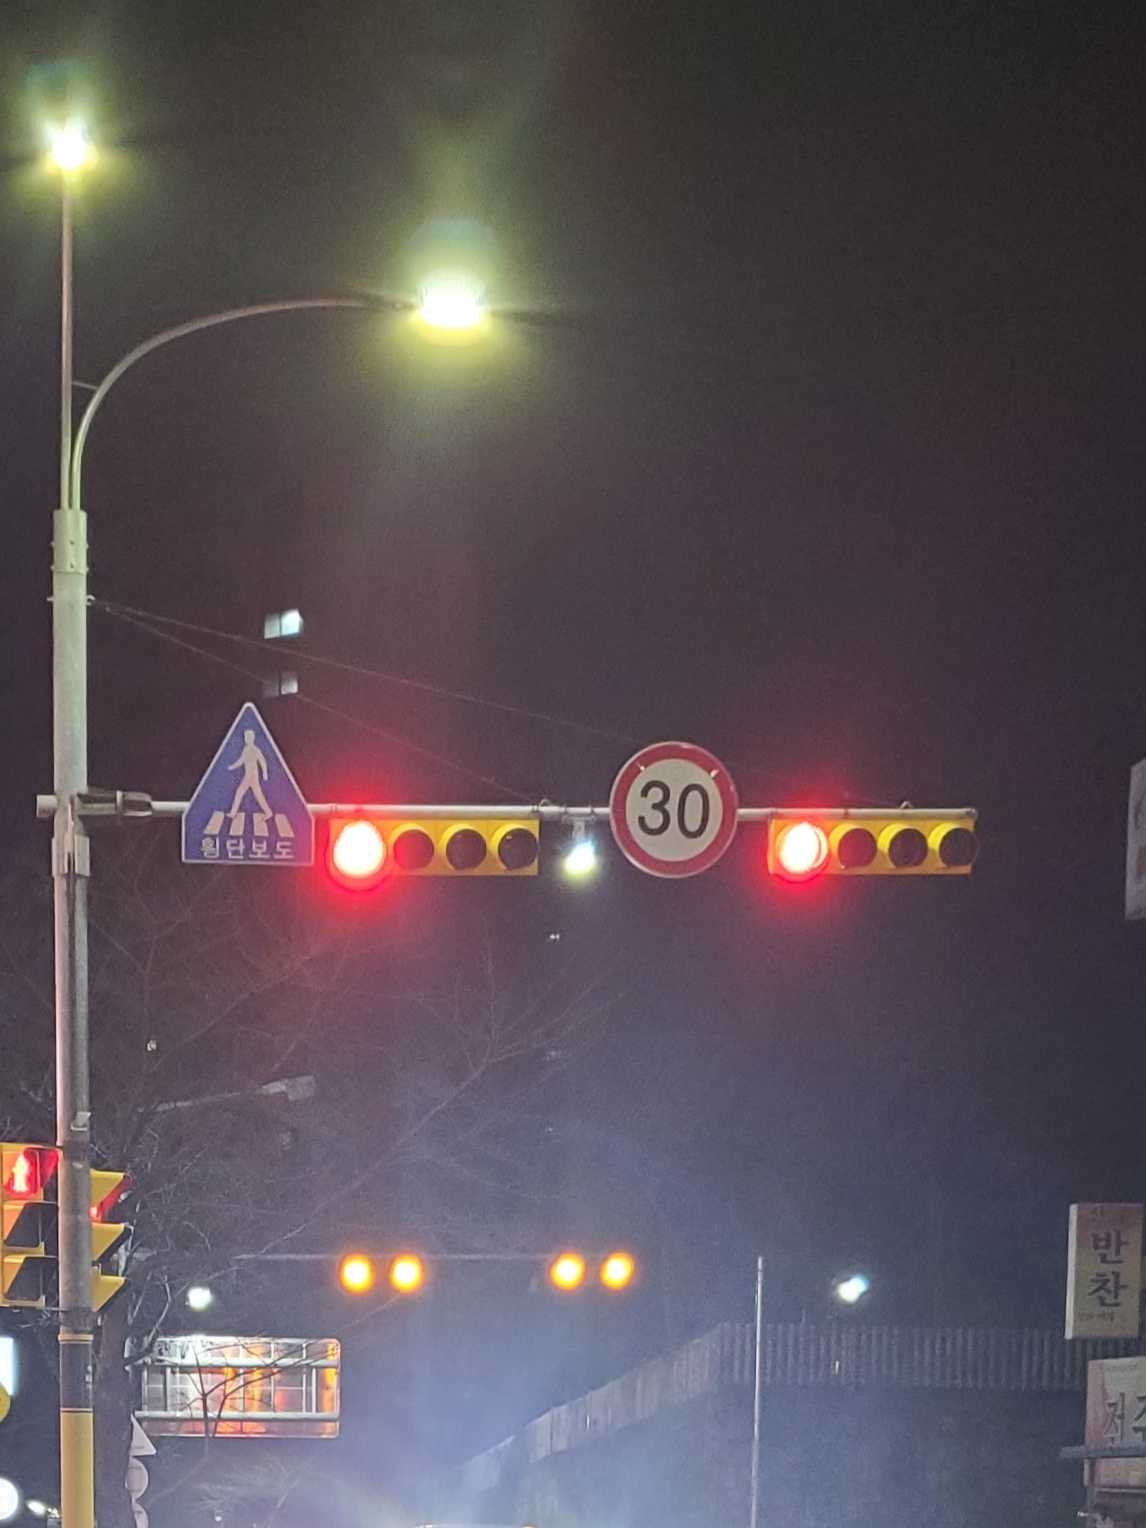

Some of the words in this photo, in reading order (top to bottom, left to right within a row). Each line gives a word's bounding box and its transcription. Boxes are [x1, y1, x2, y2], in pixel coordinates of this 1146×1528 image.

[637, 780, 711, 840] 30
[200, 837, 295, 860] 횡단보도
[1087, 1230, 1130, 1307] 반찬
